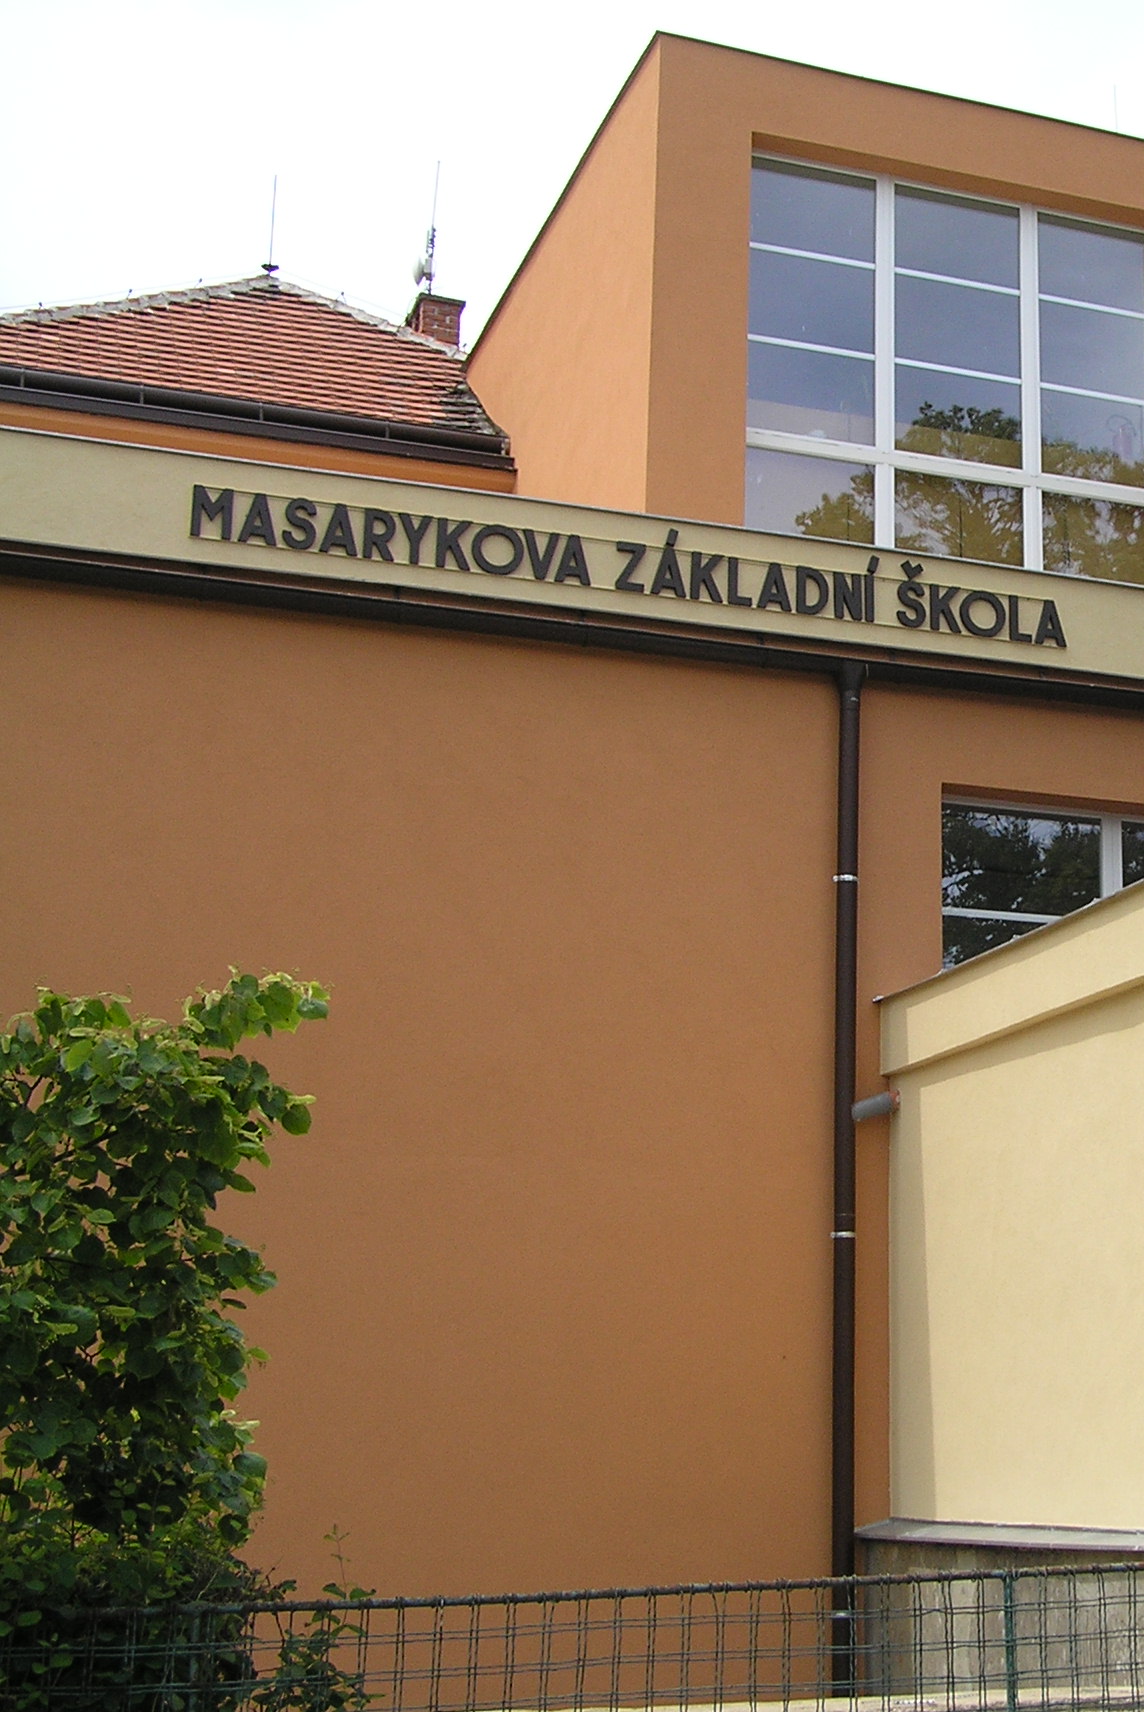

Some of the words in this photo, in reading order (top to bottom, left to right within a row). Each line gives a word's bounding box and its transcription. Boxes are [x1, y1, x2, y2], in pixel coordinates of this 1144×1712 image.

[190, 484, 590, 586] MASARYKOVA
[615, 529, 878, 622] ZÁKLADNÍ
[896, 560, 1067, 649] ŠKOLA
